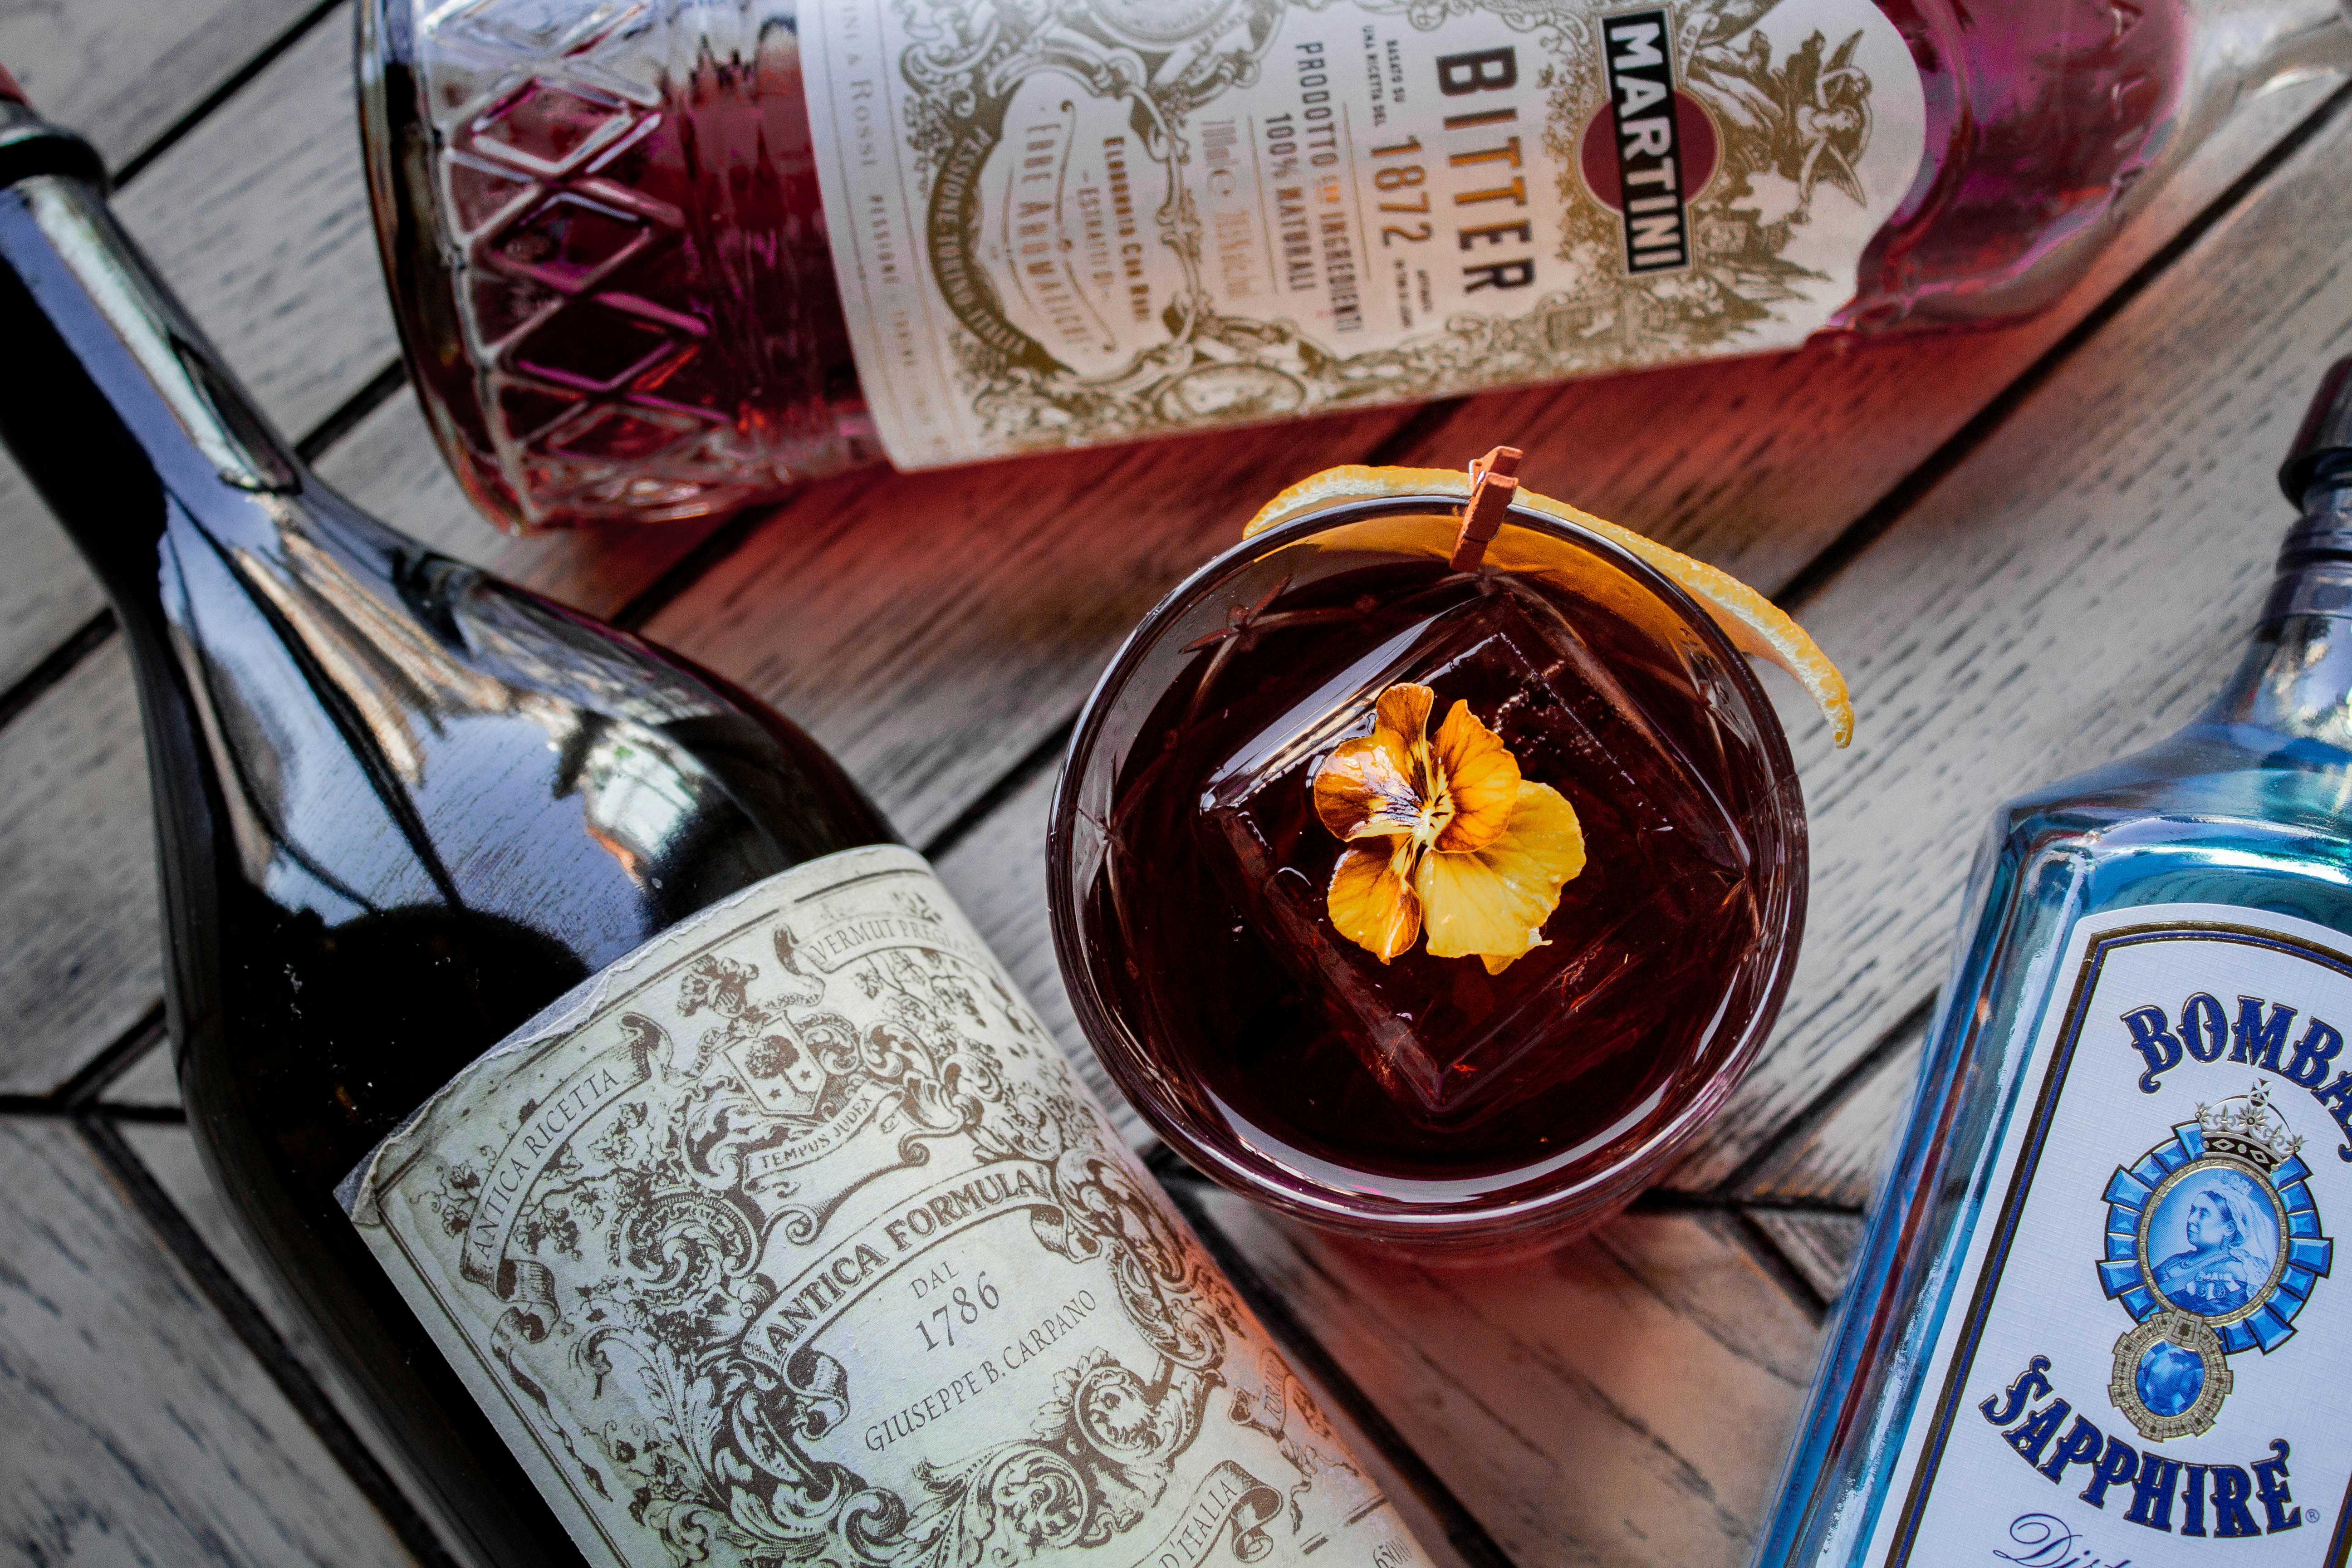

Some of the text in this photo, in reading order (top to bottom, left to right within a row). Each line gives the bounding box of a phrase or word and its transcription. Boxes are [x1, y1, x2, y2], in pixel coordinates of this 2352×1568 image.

[1361, 24, 1387, 127] UNA RICETTA DEL
[1386, 39, 1405, 103] BASATO SU
[935, 124, 993, 224] PESSIONE
[1265, 113, 1316, 291] 100% NATURALI
[1295, 42, 1339, 167] PRODOTTO
[1319, 211, 1362, 333] INGREDIENTI
[1370, 134, 1434, 248] 1872
[1436, 44, 1536, 295] BITTER
[1609, 20, 1683, 268] MARTINI
[809, 919, 896, 962] VERMUT
[696, 1029, 720, 1071] MARCA
[2120, 991, 2352, 1163] BOMBA
[473, 1067, 621, 1260] ANTICA RICETTA
[759, 1093, 873, 1169] TEMPUS JUDEX
[765, 1169, 1046, 1355] ANTICA FORMULA
[908, 1260, 959, 1300] DAL
[914, 1270, 1000, 1352] 1786
[865, 1289, 1096, 1452] GIUSEPPE B. CARPANO
[1978, 1354, 2302, 1539] SAPPHIRE
